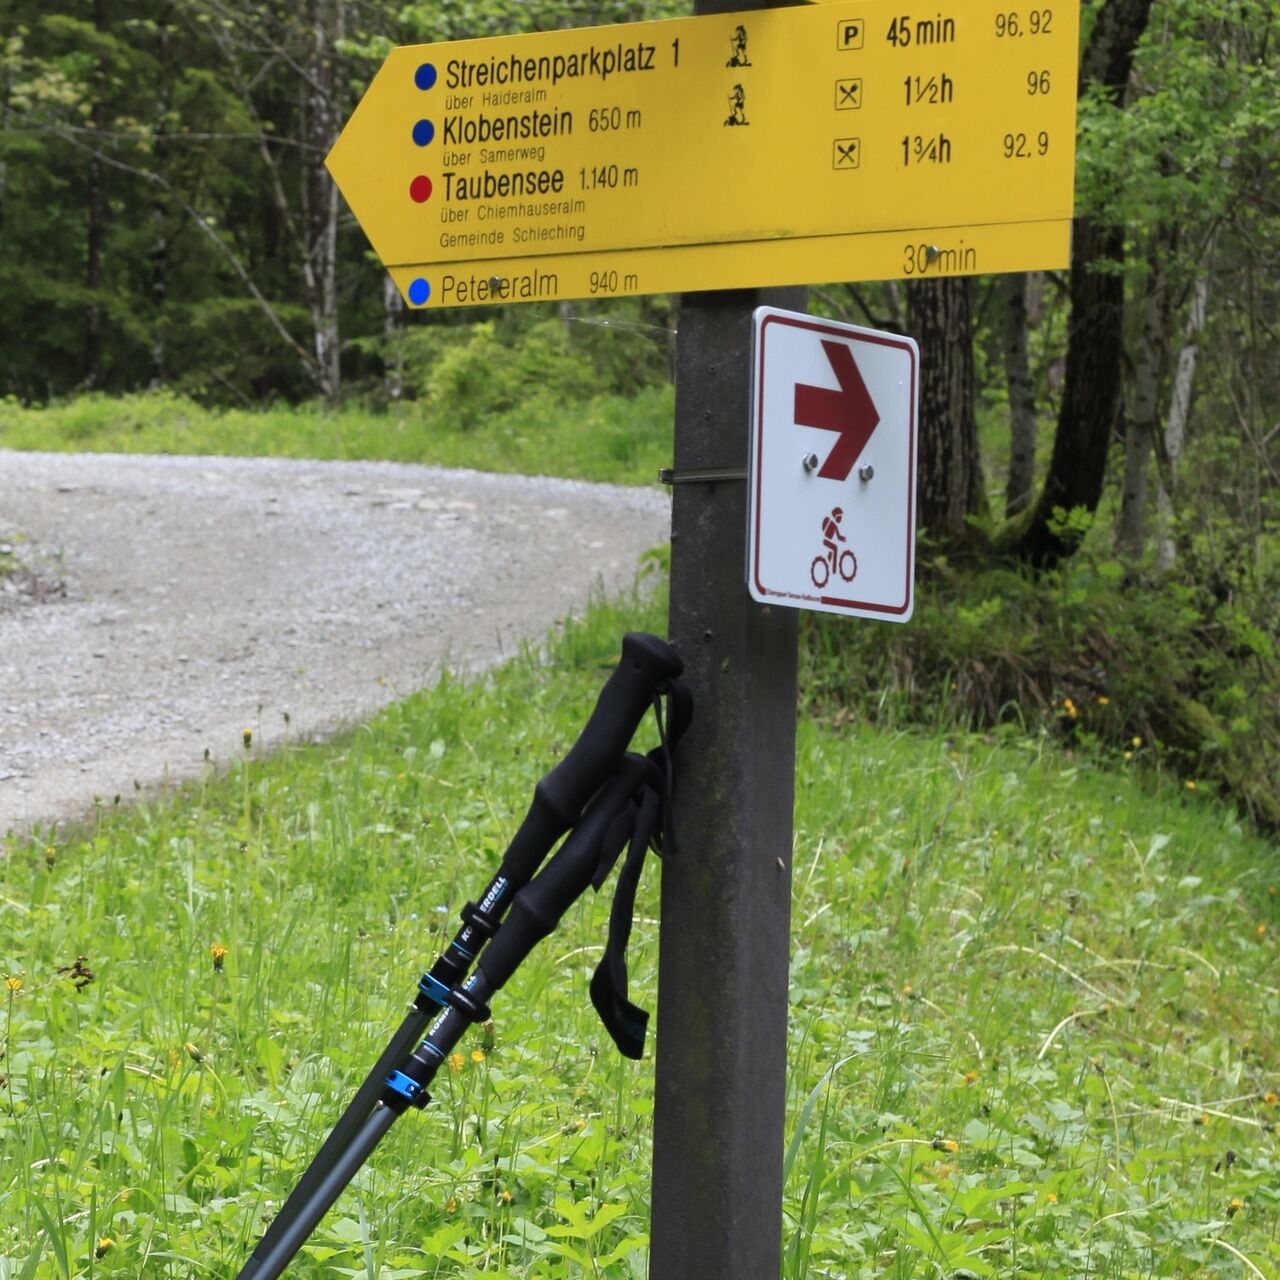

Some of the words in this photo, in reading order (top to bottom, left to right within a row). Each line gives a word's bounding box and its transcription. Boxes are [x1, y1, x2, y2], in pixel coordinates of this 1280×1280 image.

[844, 25, 859, 45] P
[886, 16, 911, 47] 45
[916, 13, 955, 45] min
[446, 42, 656, 89] Streichenparkplatz
[672, 38, 679, 67] 1
[1027, 70, 1050, 96] 96
[445, 94, 474, 111] über
[482, 88, 547, 108] Haideralm
[443, 106, 572, 145] Klobenstein
[589, 106, 621, 132] 650
[627, 109, 641, 129] m
[443, 152, 471, 167] über
[480, 146, 545, 164] Samerweg
[442, 170, 564, 202] Taubensee
[580, 164, 618, 190] 1.140
[624, 168, 638, 187] m
[440, 208, 469, 223] über
[477, 198, 585, 221] Chiemhauseralm
[440, 230, 504, 248] Gemeinde
[512, 224, 585, 244] Schleching
[903, 244, 929, 274] 30
[938, 239, 976, 272] min
[589, 270, 618, 294] 940
[623, 274, 638, 292] m
